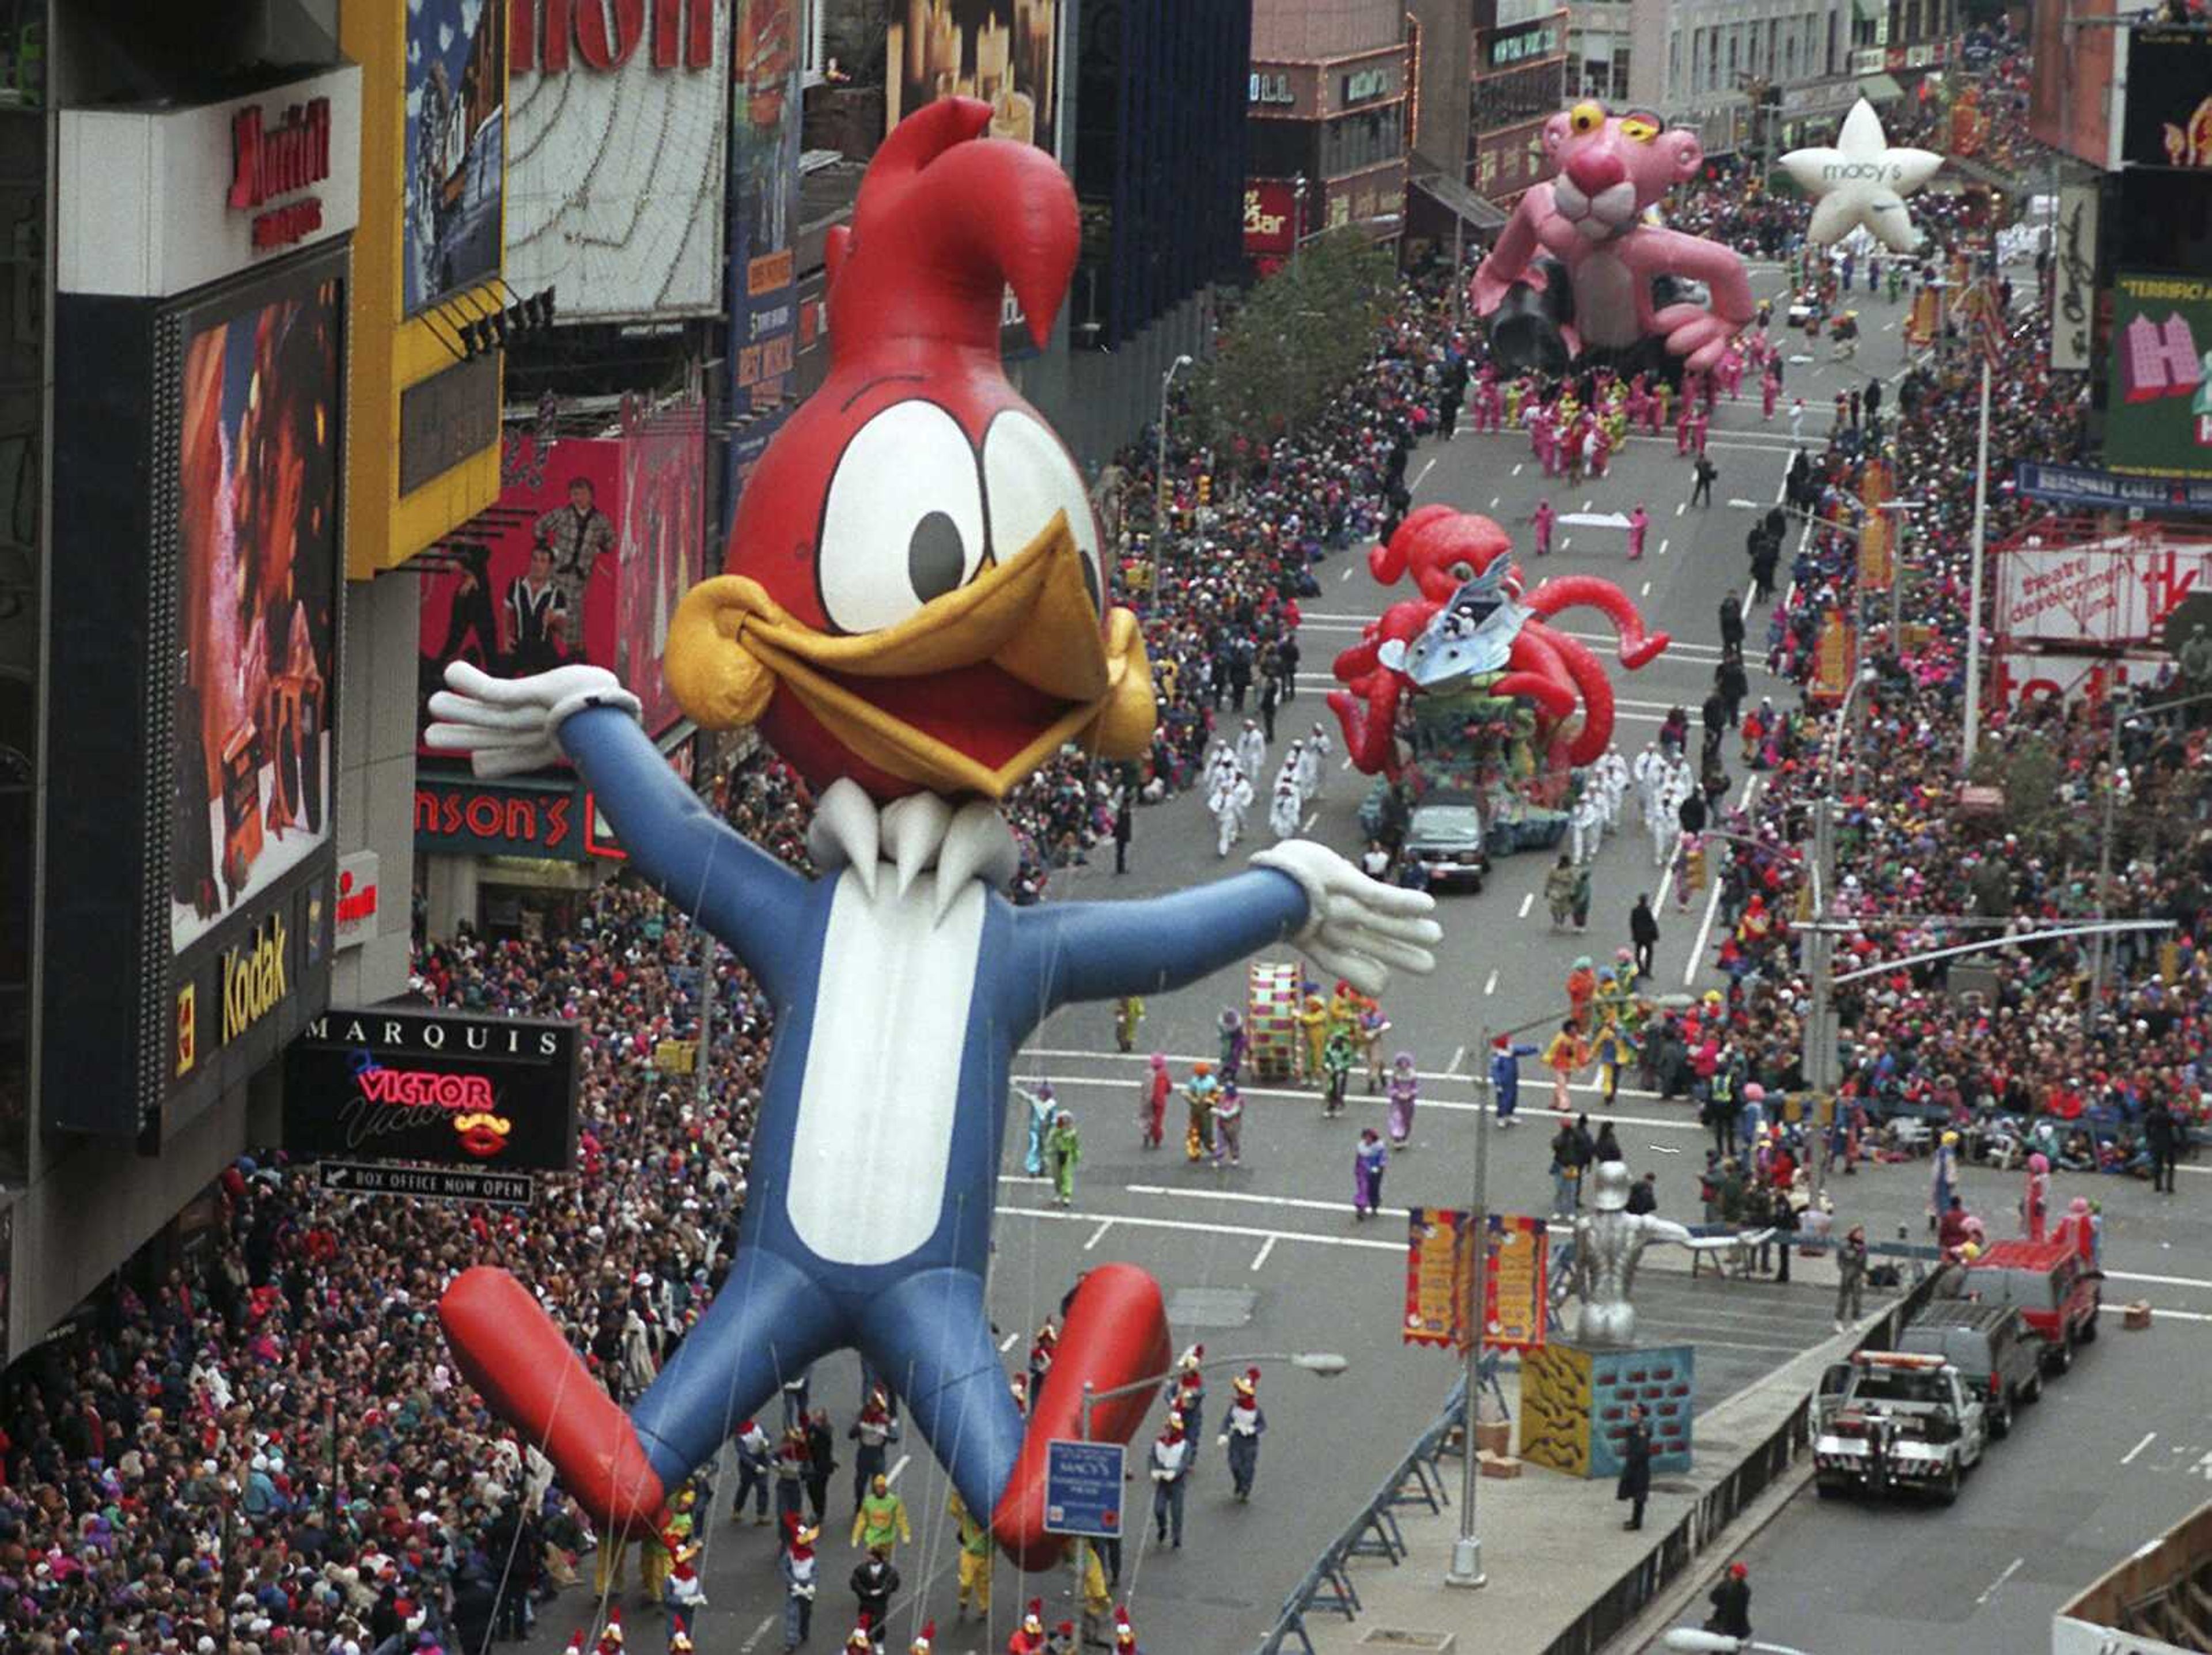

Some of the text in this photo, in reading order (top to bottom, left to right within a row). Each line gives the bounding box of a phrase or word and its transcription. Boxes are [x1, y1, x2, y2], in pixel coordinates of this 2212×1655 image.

[1823, 162, 1902, 181] macy's
[2011, 556, 2136, 623] development
[2022, 558, 2088, 596] theatre
[222, 911, 286, 1046] Kodak
[306, 1017, 557, 1055] MARQUIS
[357, 1069, 494, 1109] VICTOR
[355, 1170, 524, 1198] BOX OFFICE NOW OPEN
